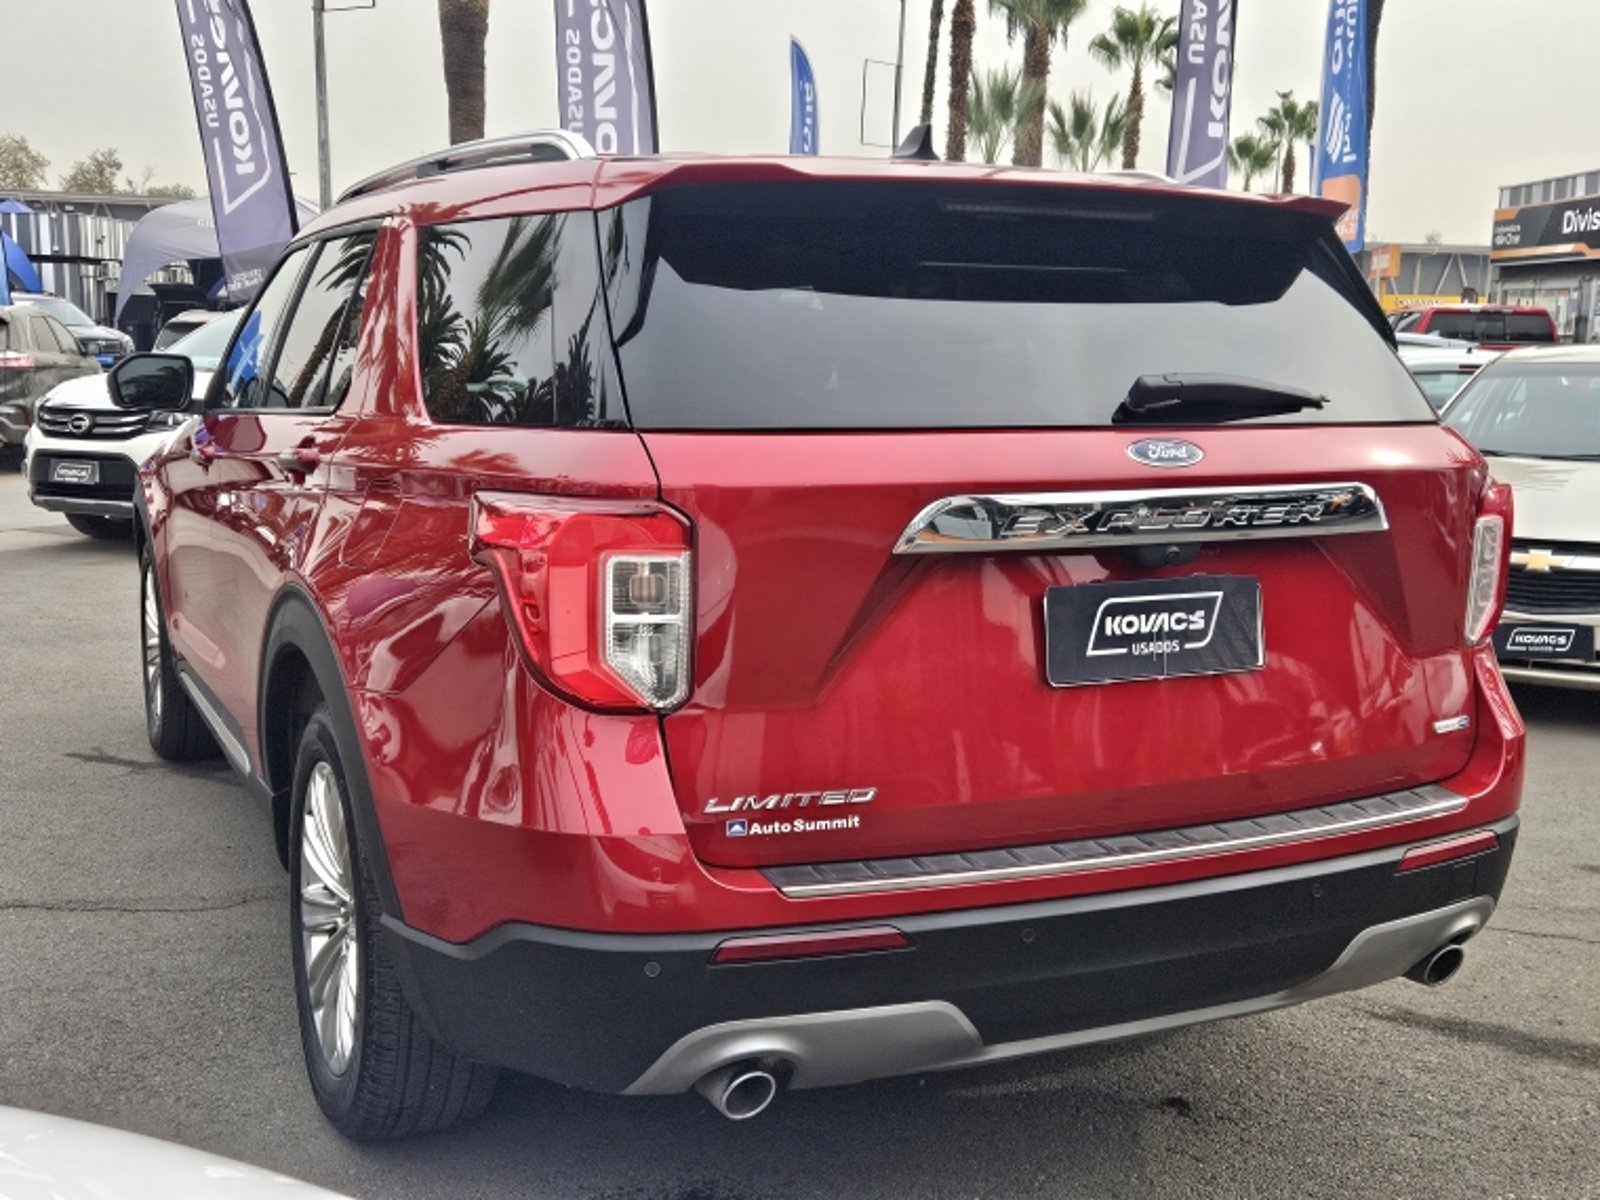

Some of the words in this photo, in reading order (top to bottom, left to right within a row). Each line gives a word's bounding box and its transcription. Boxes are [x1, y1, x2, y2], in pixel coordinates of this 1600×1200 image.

[1148, 443, 1188, 459] Ford
[1000, 501, 1326, 536] EXPLORER
[1104, 609, 1206, 637] KOVACS
[1131, 640, 1180, 656] USADOS
[703, 786, 878, 813] LIMITED
